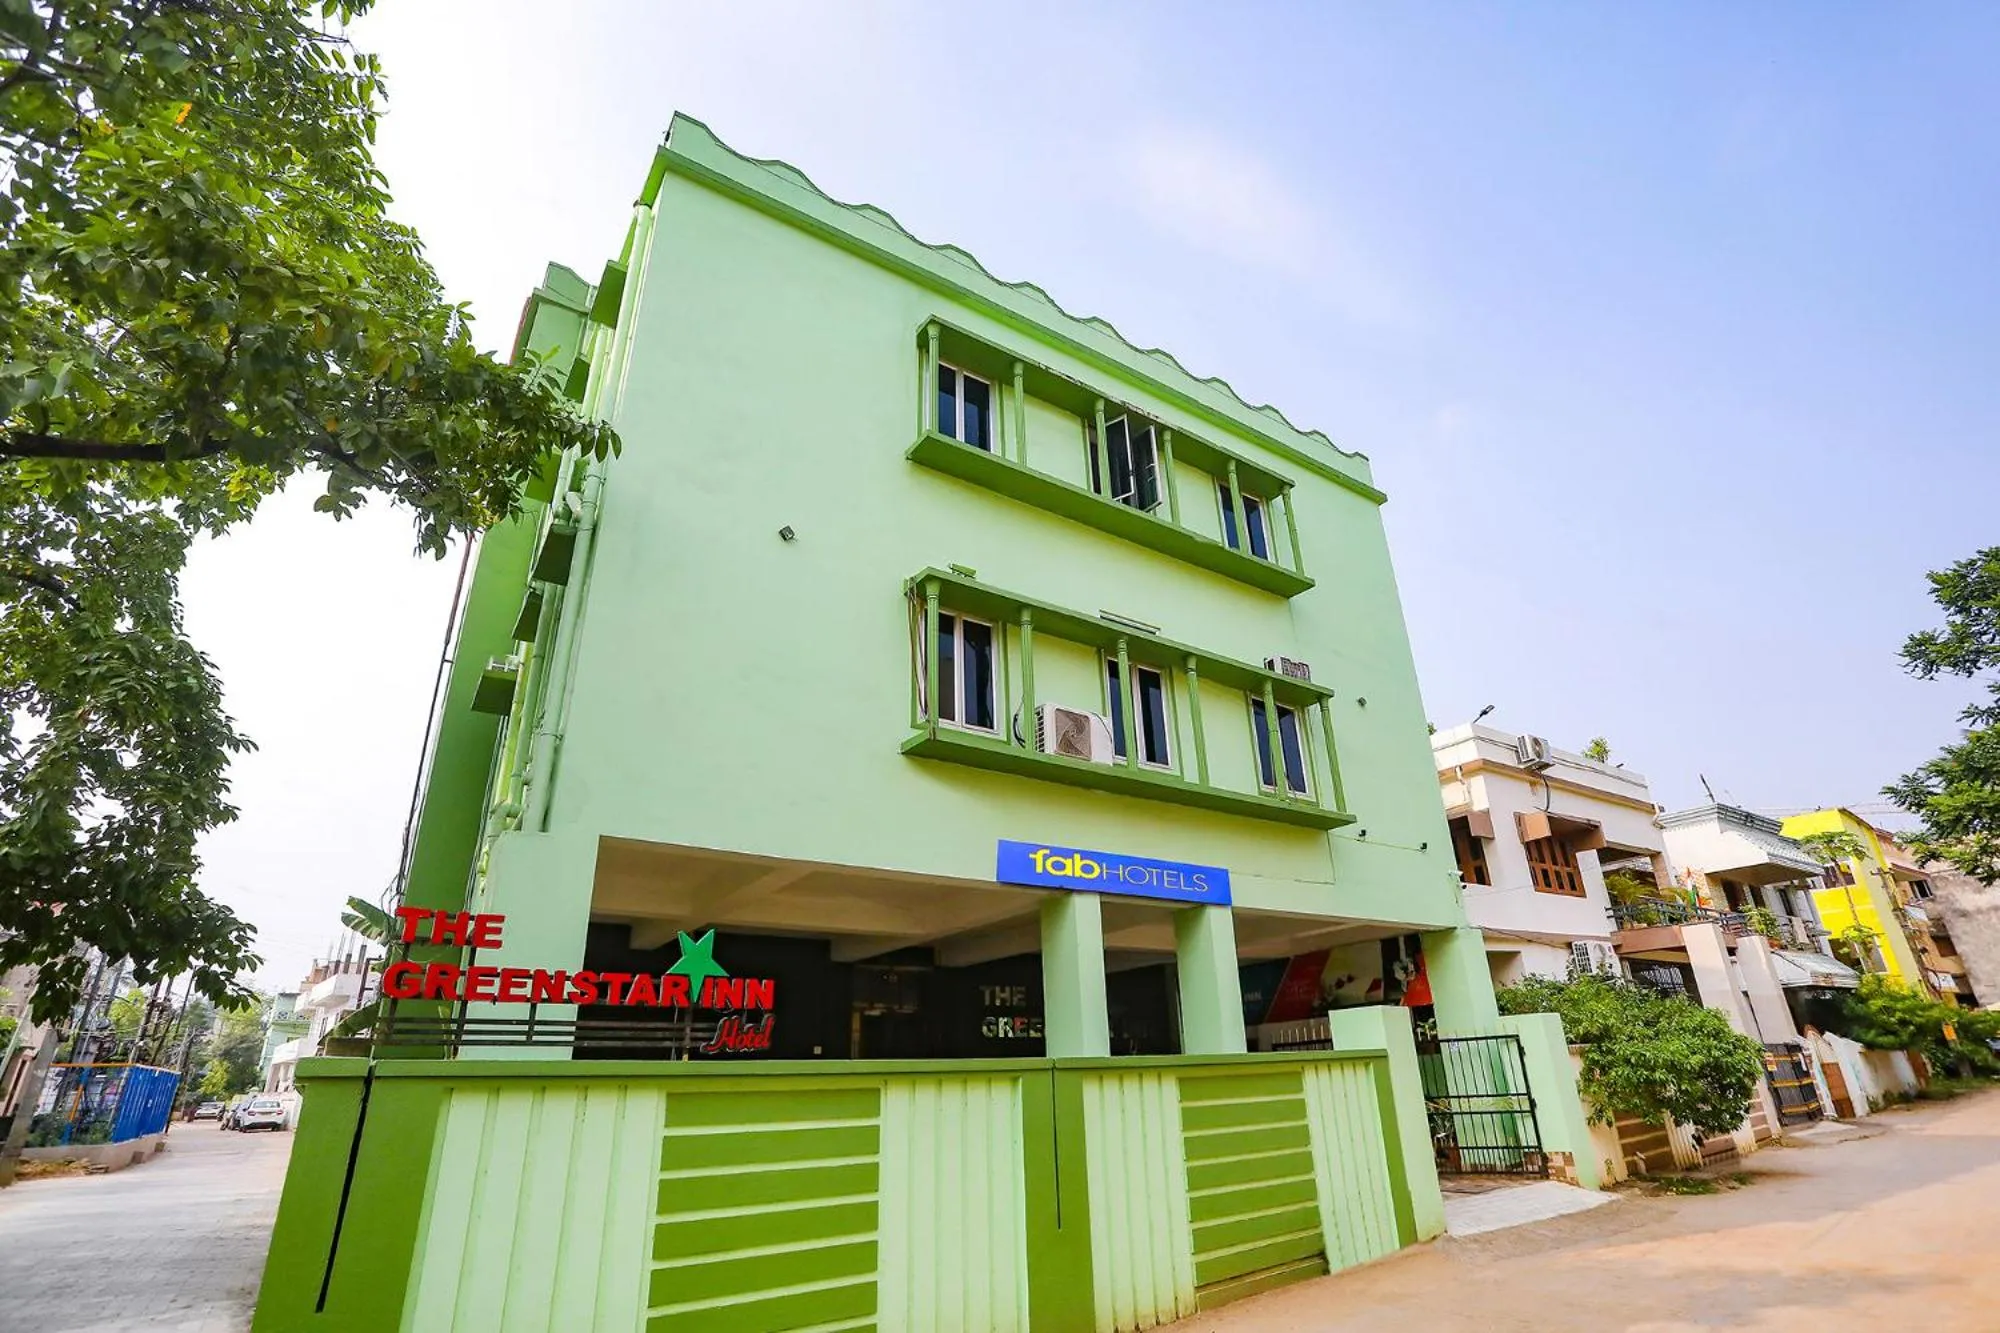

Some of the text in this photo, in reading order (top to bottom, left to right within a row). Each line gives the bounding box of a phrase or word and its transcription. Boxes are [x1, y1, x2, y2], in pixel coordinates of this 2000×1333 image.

[395, 906, 505, 949] THE
[383, 961, 774, 1009] GREENSTAR INN
[979, 985, 1027, 1006] THE
[701, 1013, 775, 1053] Hotel
